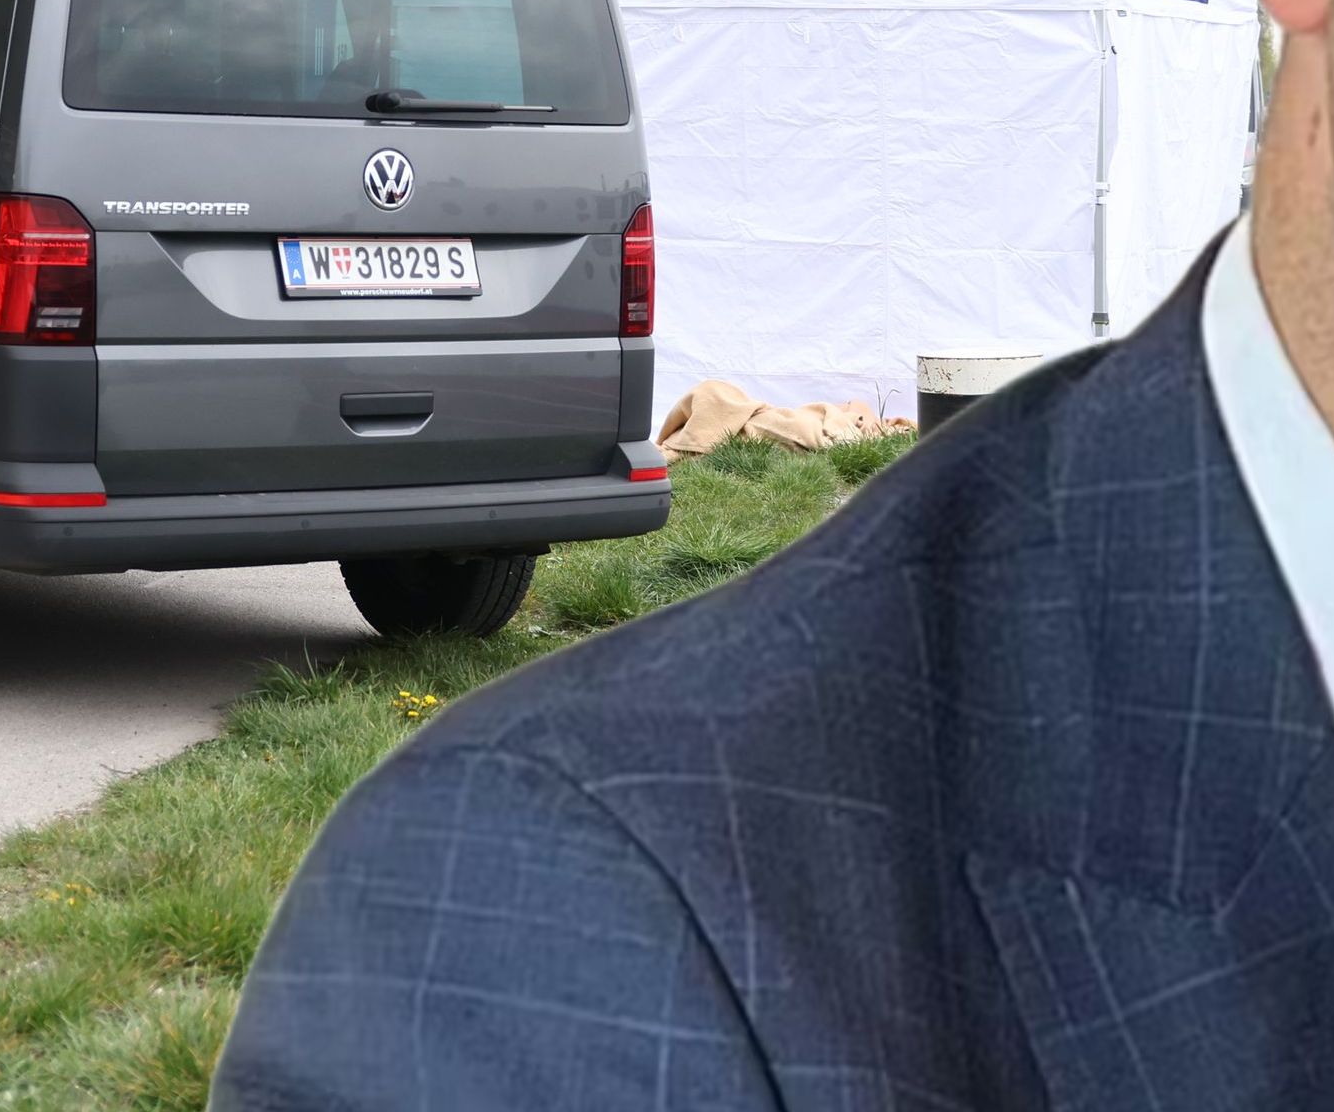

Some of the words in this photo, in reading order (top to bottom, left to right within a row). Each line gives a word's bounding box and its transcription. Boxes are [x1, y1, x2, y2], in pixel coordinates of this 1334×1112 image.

[103, 200, 250, 216] TRANSPORTER
[308, 246, 331, 280] W
[355, 246, 440, 279] 31829
[447, 246, 465, 279] S
[292, 269, 302, 279] A
